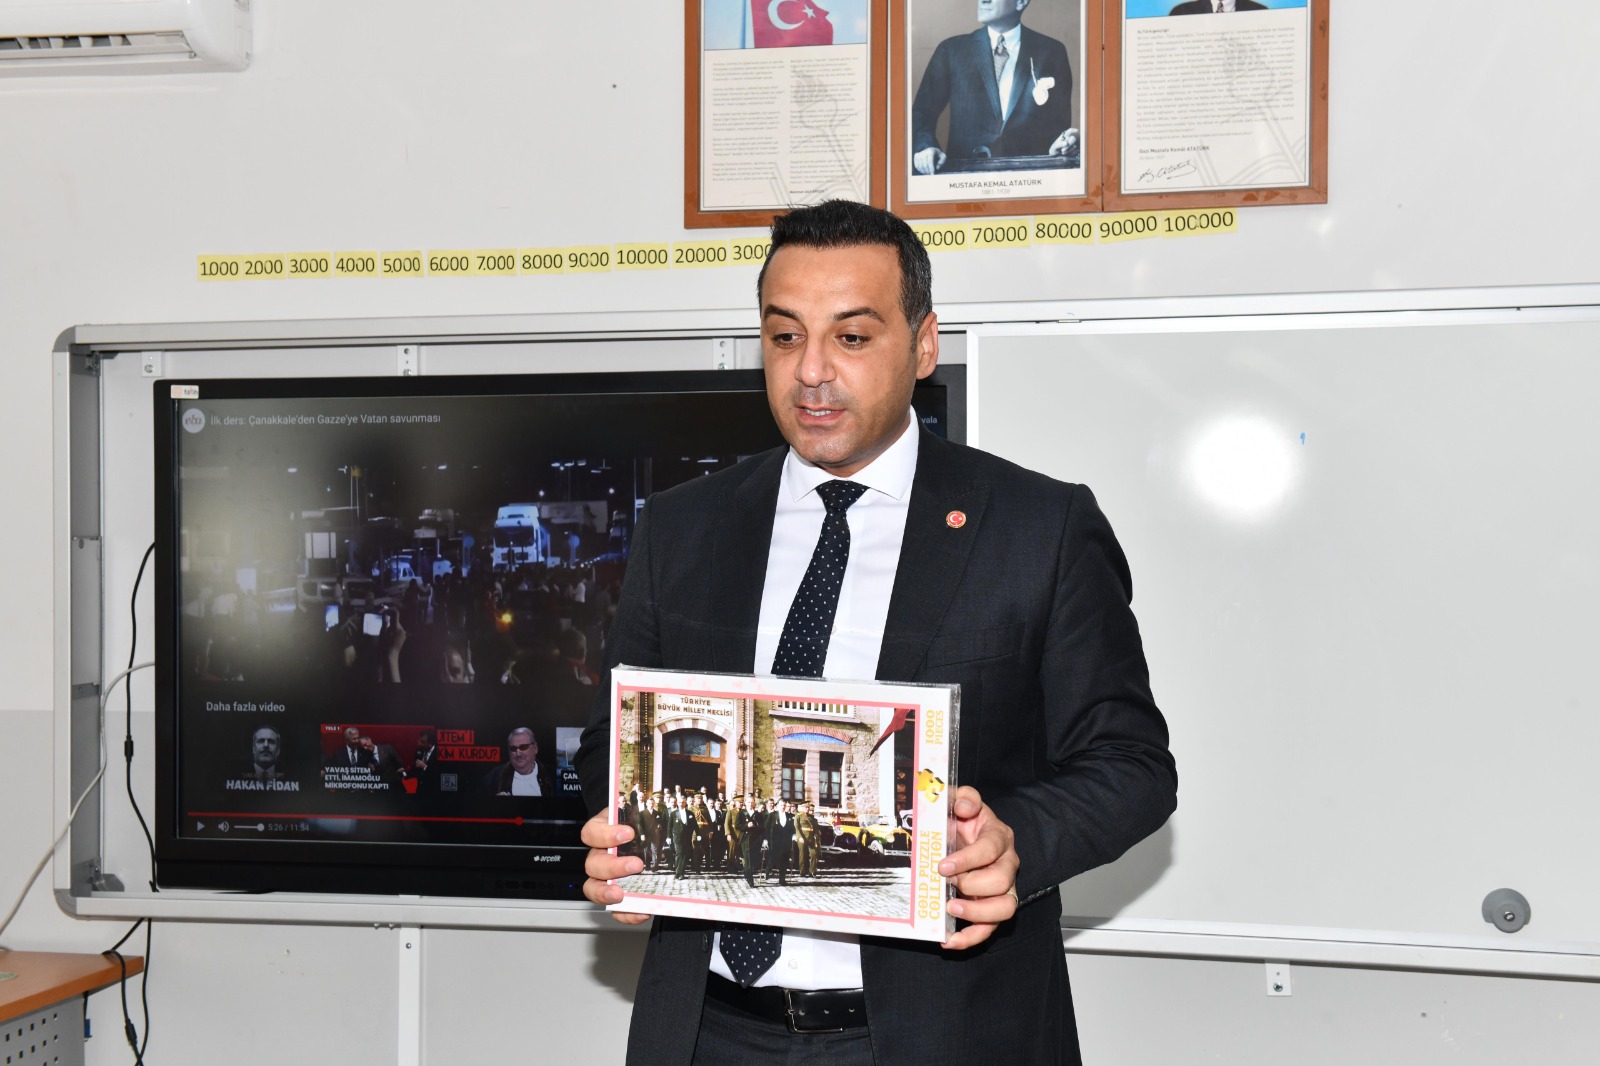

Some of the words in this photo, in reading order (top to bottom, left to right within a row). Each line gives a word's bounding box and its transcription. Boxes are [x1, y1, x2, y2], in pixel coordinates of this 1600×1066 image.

[949, 181, 982, 189] MUSTAFA
[984, 180, 1008, 188] KEMAL
[1009, 178, 1042, 187] ATATÜRK
[223, 414, 246, 426] ders:
[249, 414, 315, 427] Çanakkale'den
[317, 413, 358, 426] Gazze'ye
[361, 413, 388, 424] Vatan
[390, 413, 441, 424] savunması
[206, 701, 231, 712] Daha
[233, 702, 256, 712] fazla
[259, 702, 285, 712] video
[680, 696, 711, 706] TÜRKİYE
[657, 703, 680, 712] BÜYÜK
[683, 706, 705, 714] MİLLET
[707, 708, 733, 716] MECLİSİ
[926, 709, 935, 744] 1000
[935, 709, 944, 745] PIECES
[458, 748, 498, 760] KURDU?
[325, 766, 349, 775] YAVAŞ
[350, 765, 371, 773] SİTEM
[342, 773, 381, 781] İMAMOĞLU
[563, 772, 579, 781] ÇAN
[226, 780, 264, 790] HAKAN
[266, 778, 299, 791] FİDAN
[325, 781, 367, 789] MİKROFONU
[268, 823, 283, 831] 5:26
[919, 830, 930, 878] PUZZLE
[929, 831, 942, 920] COLLECTION
[918, 881, 929, 919] GOLD
